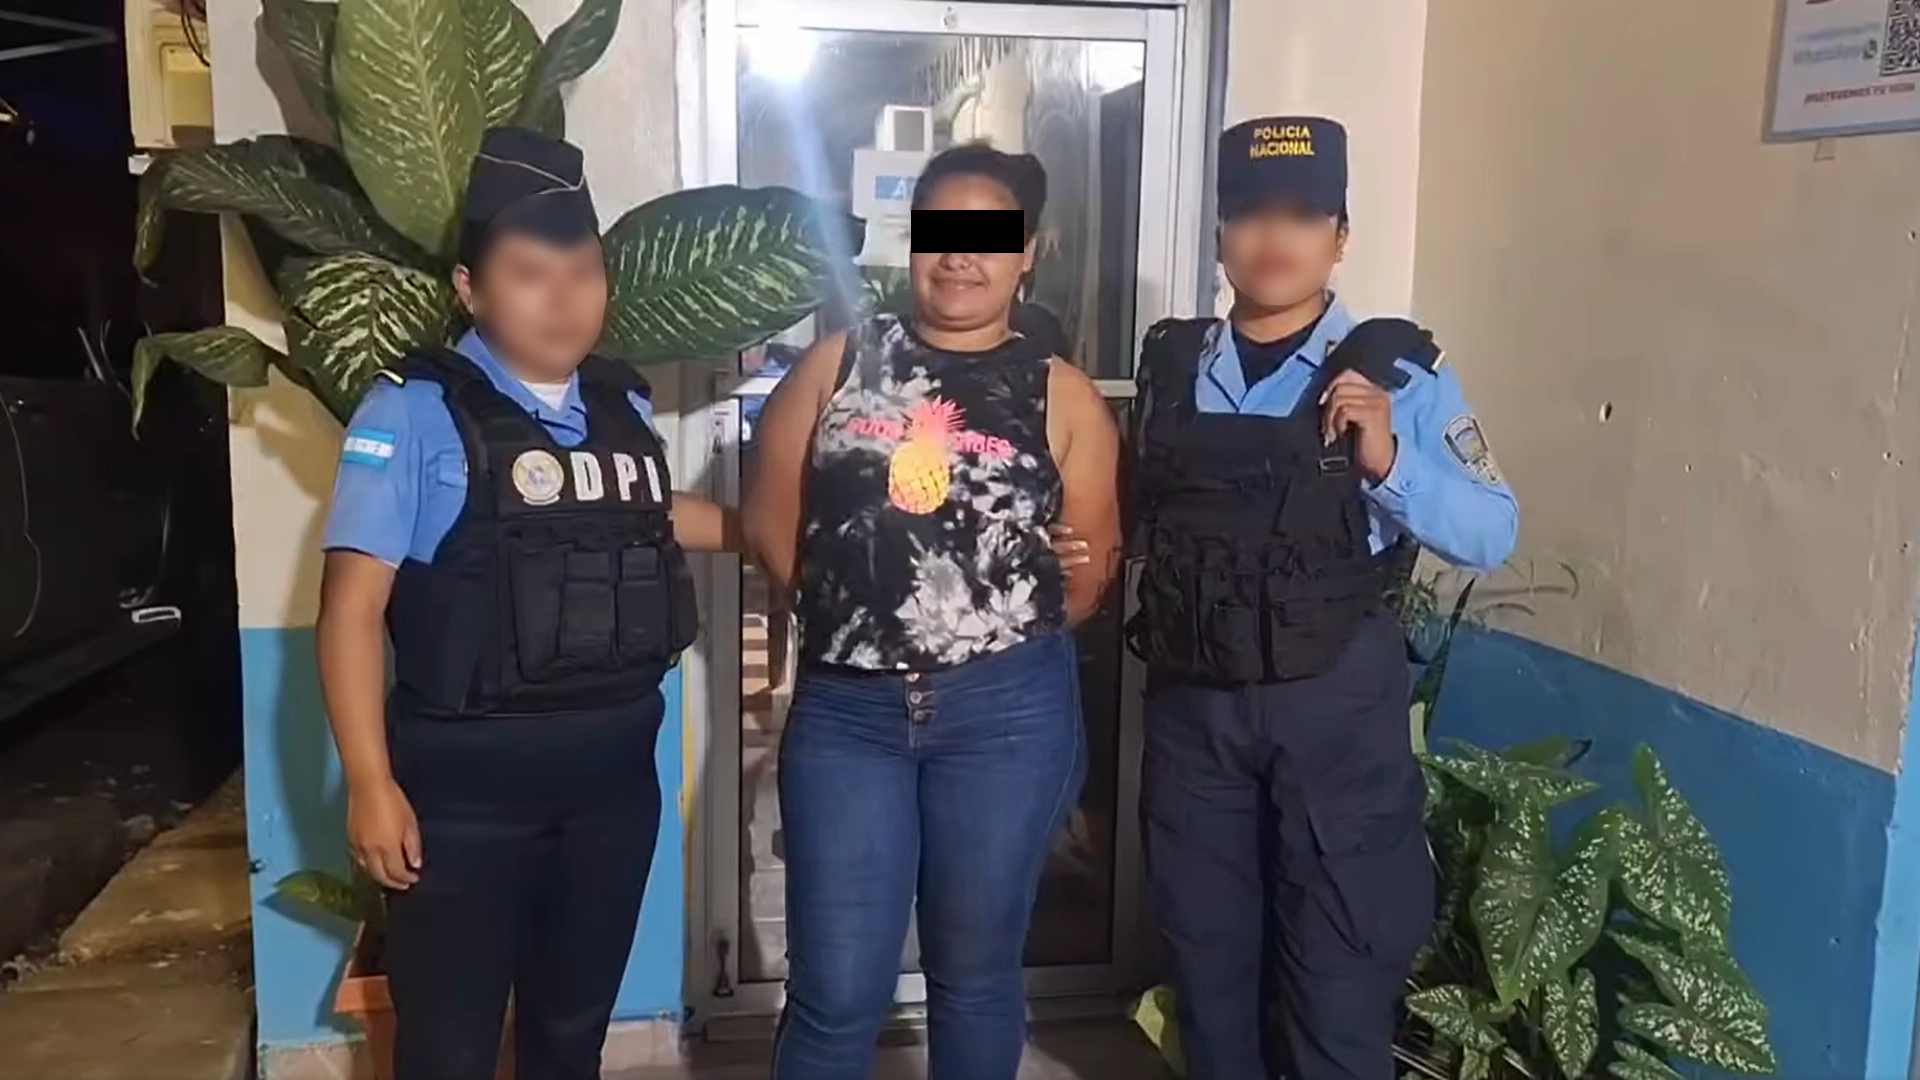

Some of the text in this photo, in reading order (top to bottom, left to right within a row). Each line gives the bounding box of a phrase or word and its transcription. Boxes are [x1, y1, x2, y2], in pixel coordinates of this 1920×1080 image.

[1253, 125, 1312, 140] POLICIA
[1249, 141, 1315, 158] NACIONAL
[570, 451, 663, 503] DPI
